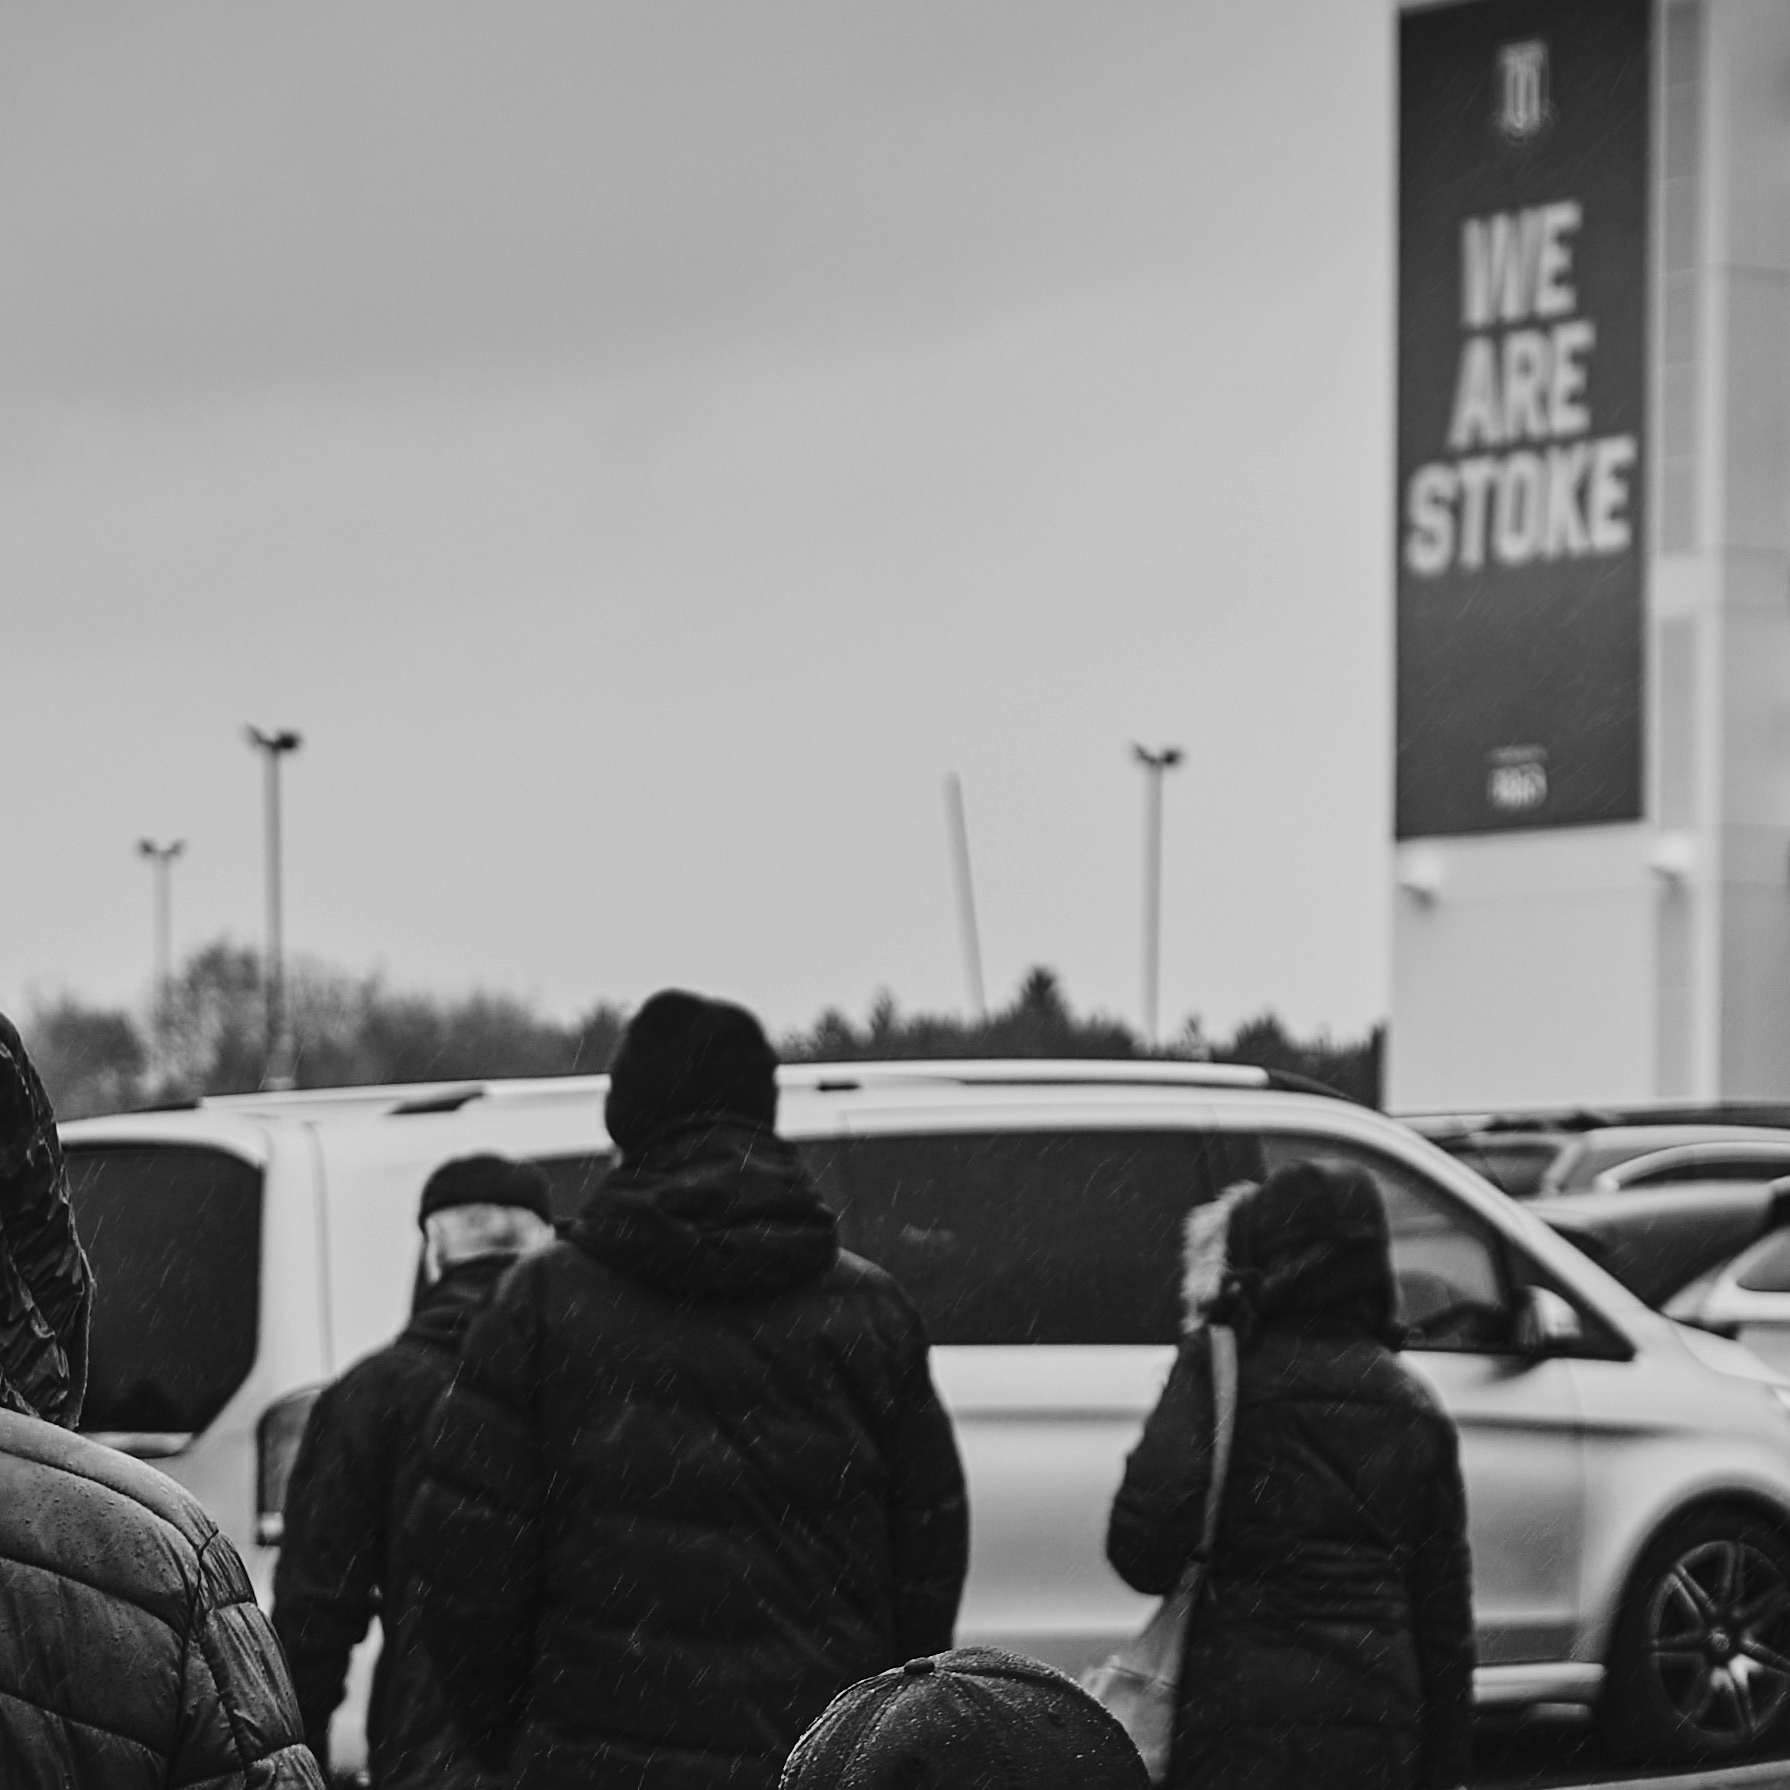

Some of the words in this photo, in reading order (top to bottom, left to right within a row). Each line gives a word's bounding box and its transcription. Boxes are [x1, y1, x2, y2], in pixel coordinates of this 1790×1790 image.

[1462, 202, 1582, 326] WE
[1449, 321, 1595, 452] ARE
[1406, 435, 1638, 576] STOKE
